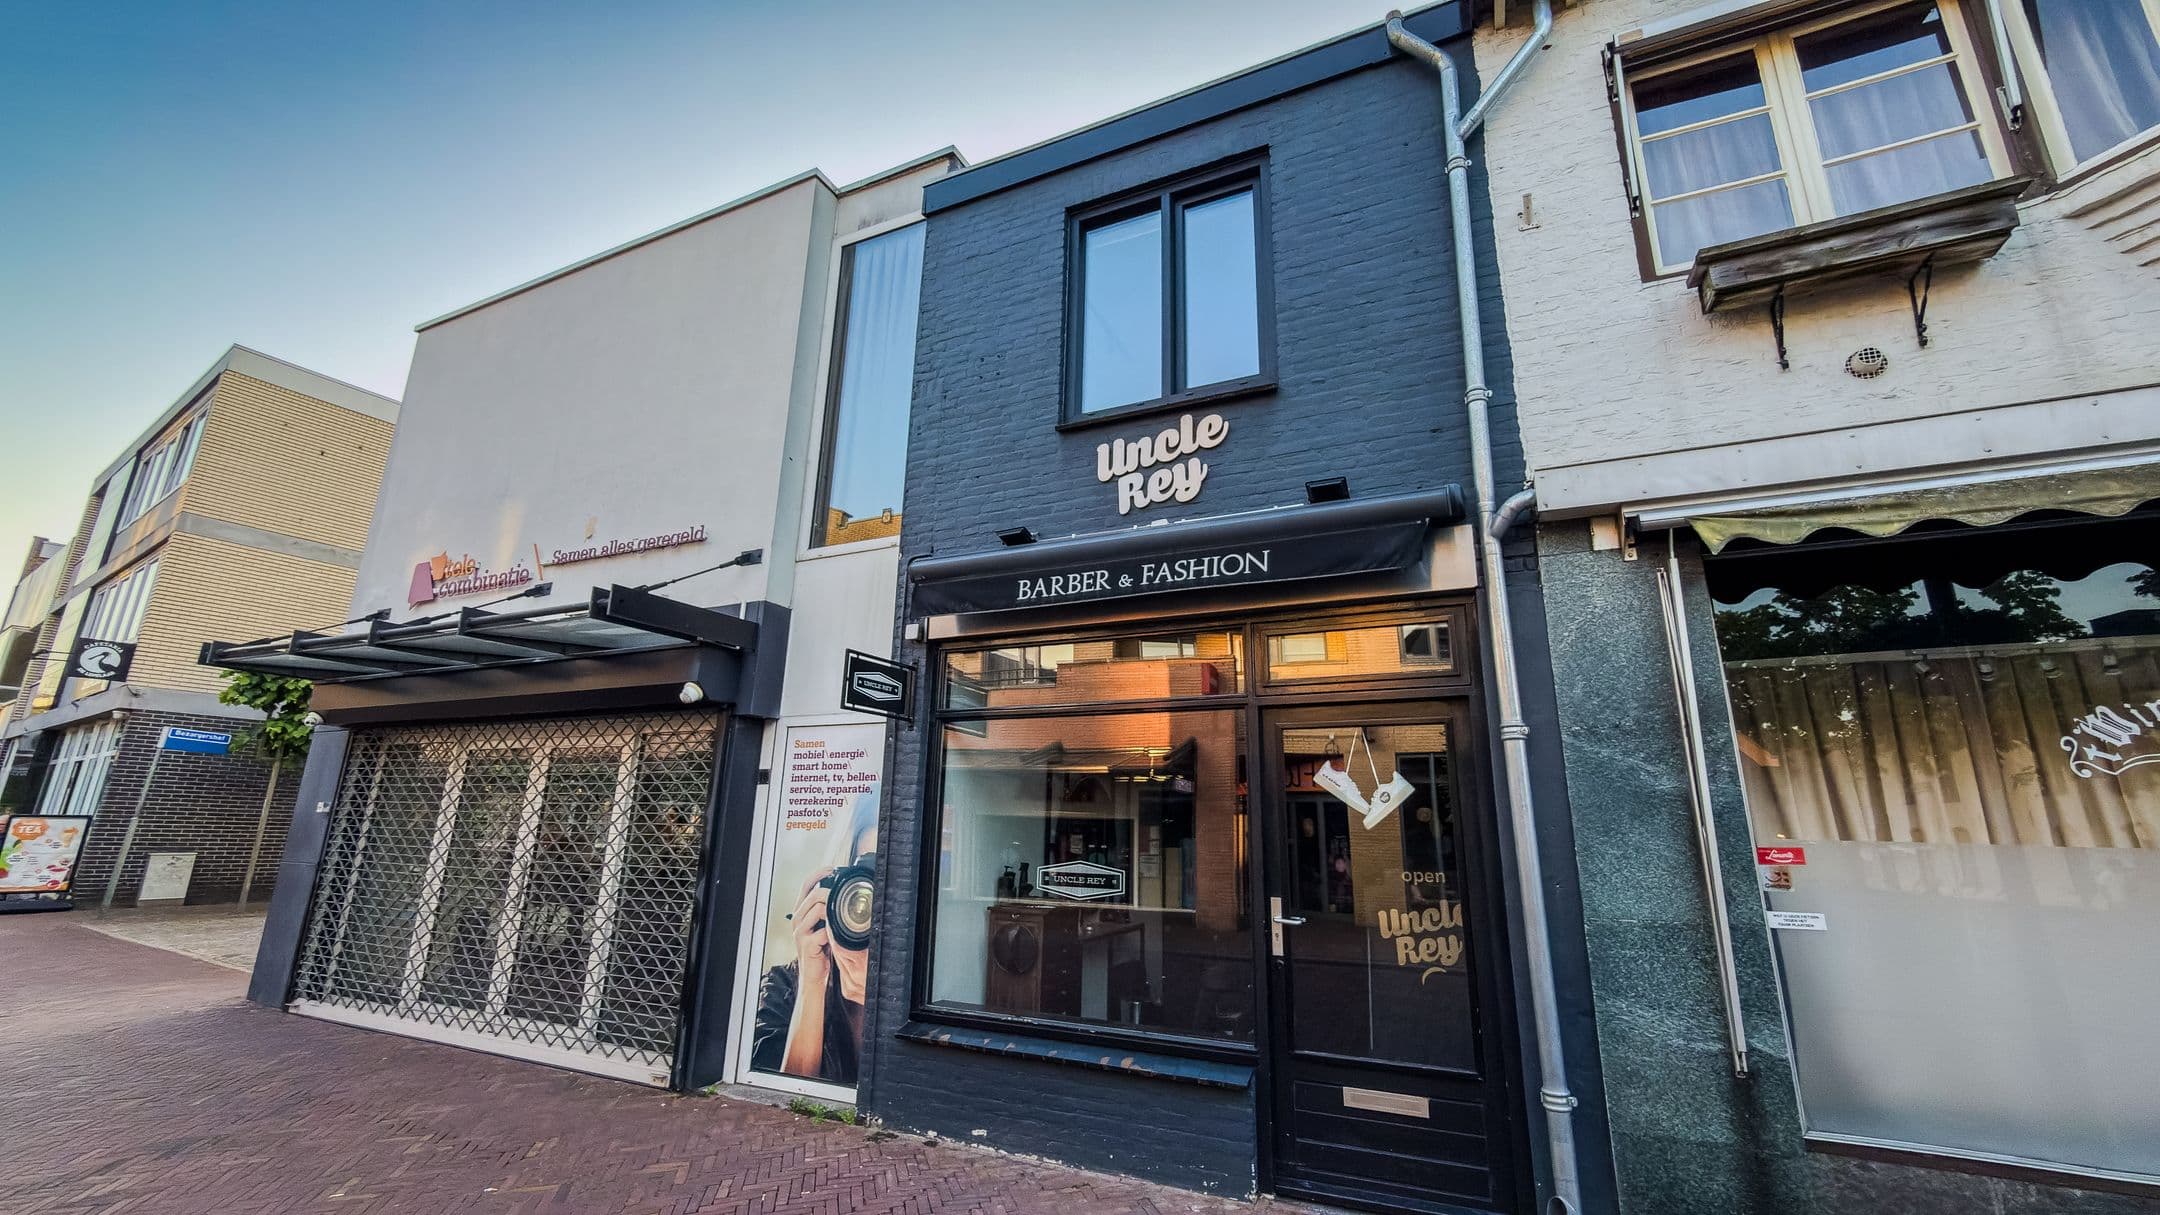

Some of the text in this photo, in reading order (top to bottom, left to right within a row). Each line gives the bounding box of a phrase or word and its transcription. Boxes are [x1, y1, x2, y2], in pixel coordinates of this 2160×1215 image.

[1097, 414, 1229, 482] Uncle
[1117, 458, 1208, 515] Rey
[552, 525, 707, 565] Samen alles geregeld
[440, 565, 531, 599] combinatie
[1016, 550, 1271, 600] BARBER & FASHION
[794, 739, 825, 749] Samen
[792, 762, 819, 771] smart
[791, 773, 830, 783] internet,
[832, 774, 844, 783] tv,
[789, 783, 873, 796] service, reparatie,
[786, 820, 827, 831] geregeld
[1053, 875, 1106, 885] UNCLE REY
[1401, 870, 1446, 886] open
[1396, 935, 1463, 966] Rey
